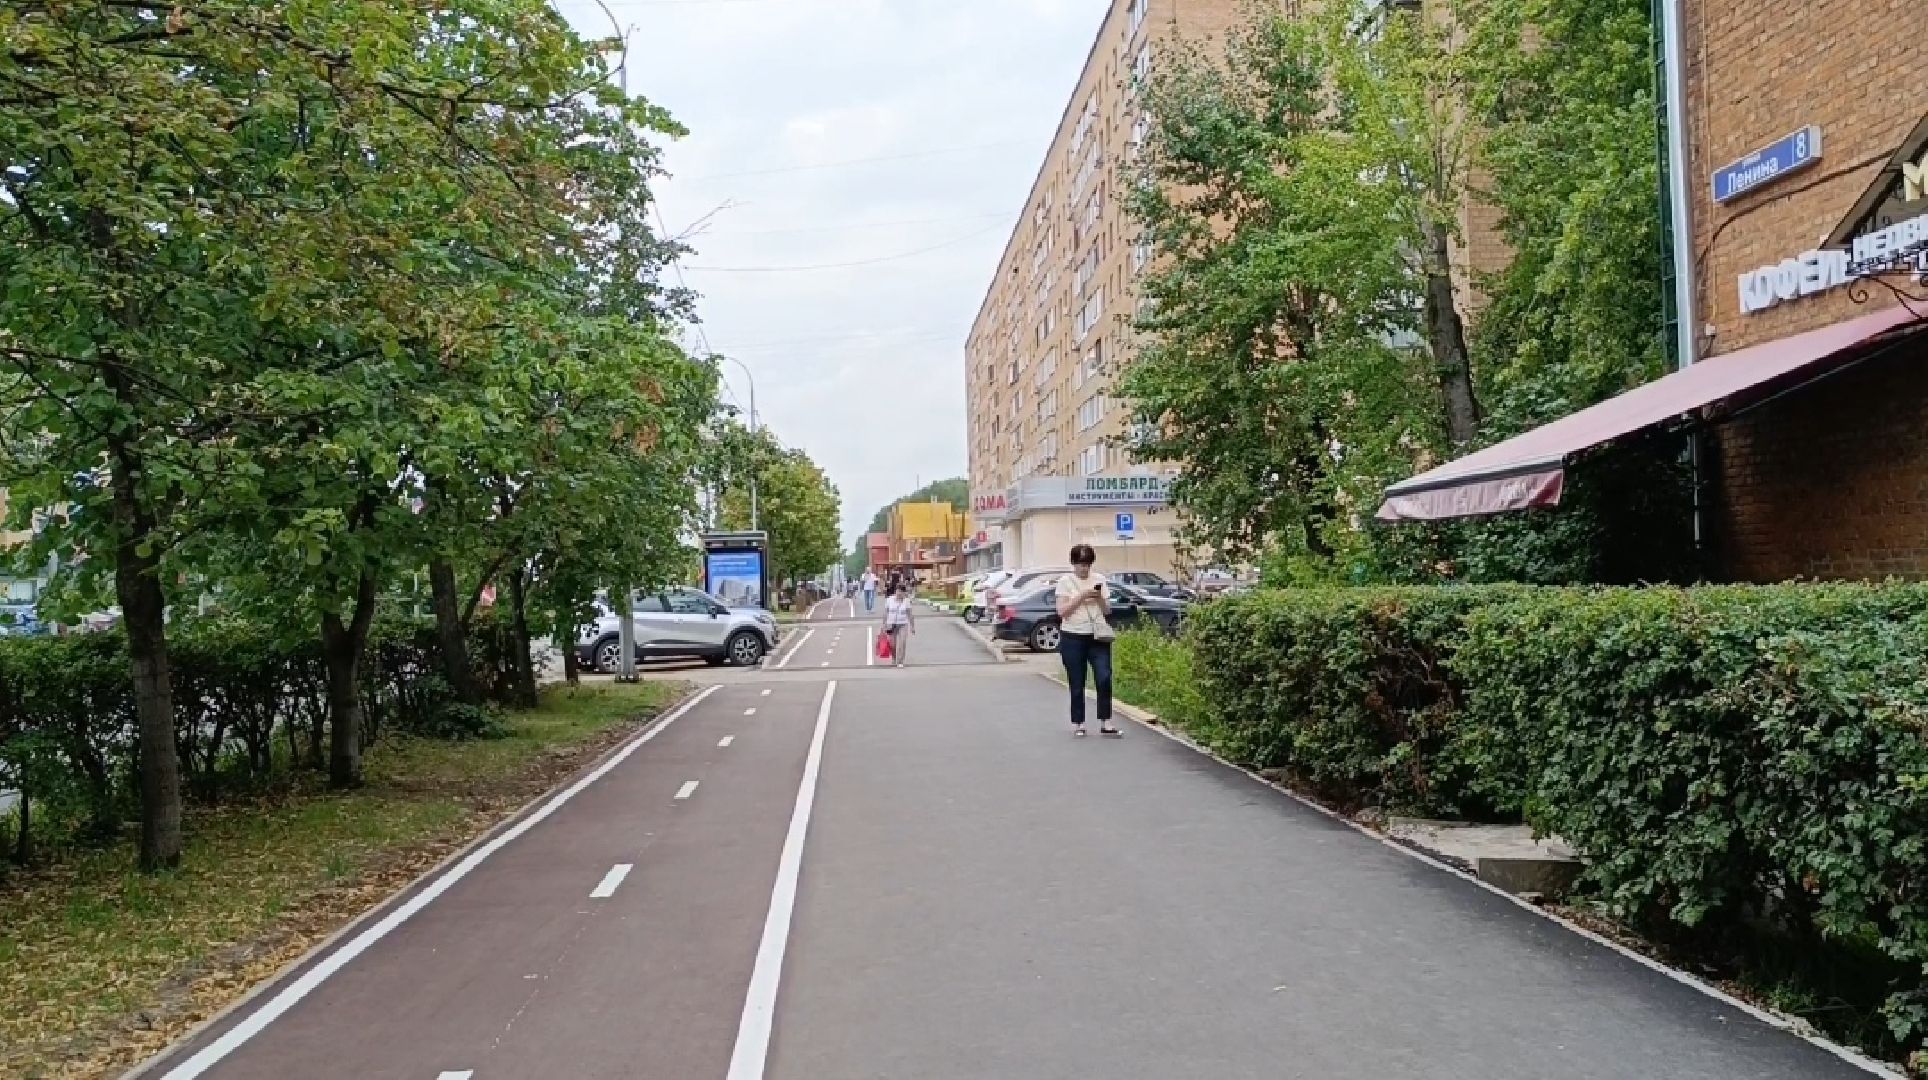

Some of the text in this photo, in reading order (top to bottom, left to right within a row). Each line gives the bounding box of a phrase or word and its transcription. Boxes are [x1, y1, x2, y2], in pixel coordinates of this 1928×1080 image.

[1728, 157, 1779, 193] Ленина
[1796, 132, 1805, 158] 8
[1086, 477, 1159, 491] ЛОМБАРД
